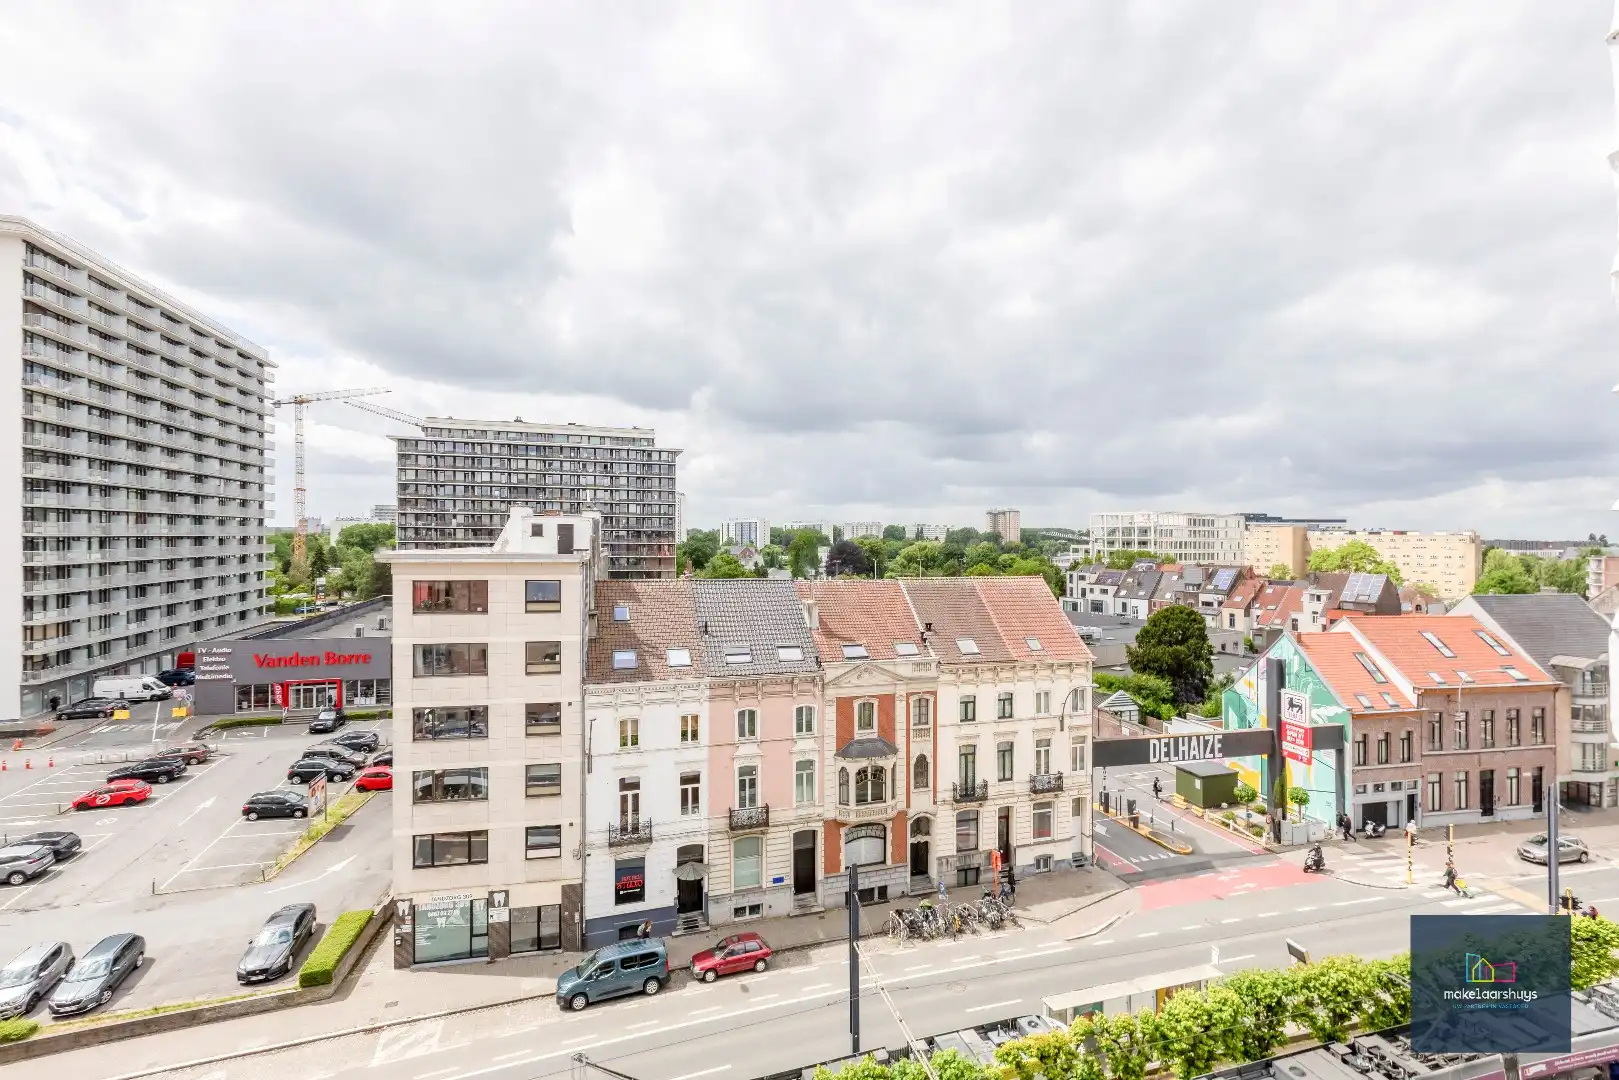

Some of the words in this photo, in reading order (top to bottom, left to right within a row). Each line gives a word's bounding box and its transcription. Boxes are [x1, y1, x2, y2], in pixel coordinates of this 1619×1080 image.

[253, 651, 320, 668] Vanden
[324, 651, 372, 666] Borre
[1149, 735, 1223, 763] DELHAIZE
